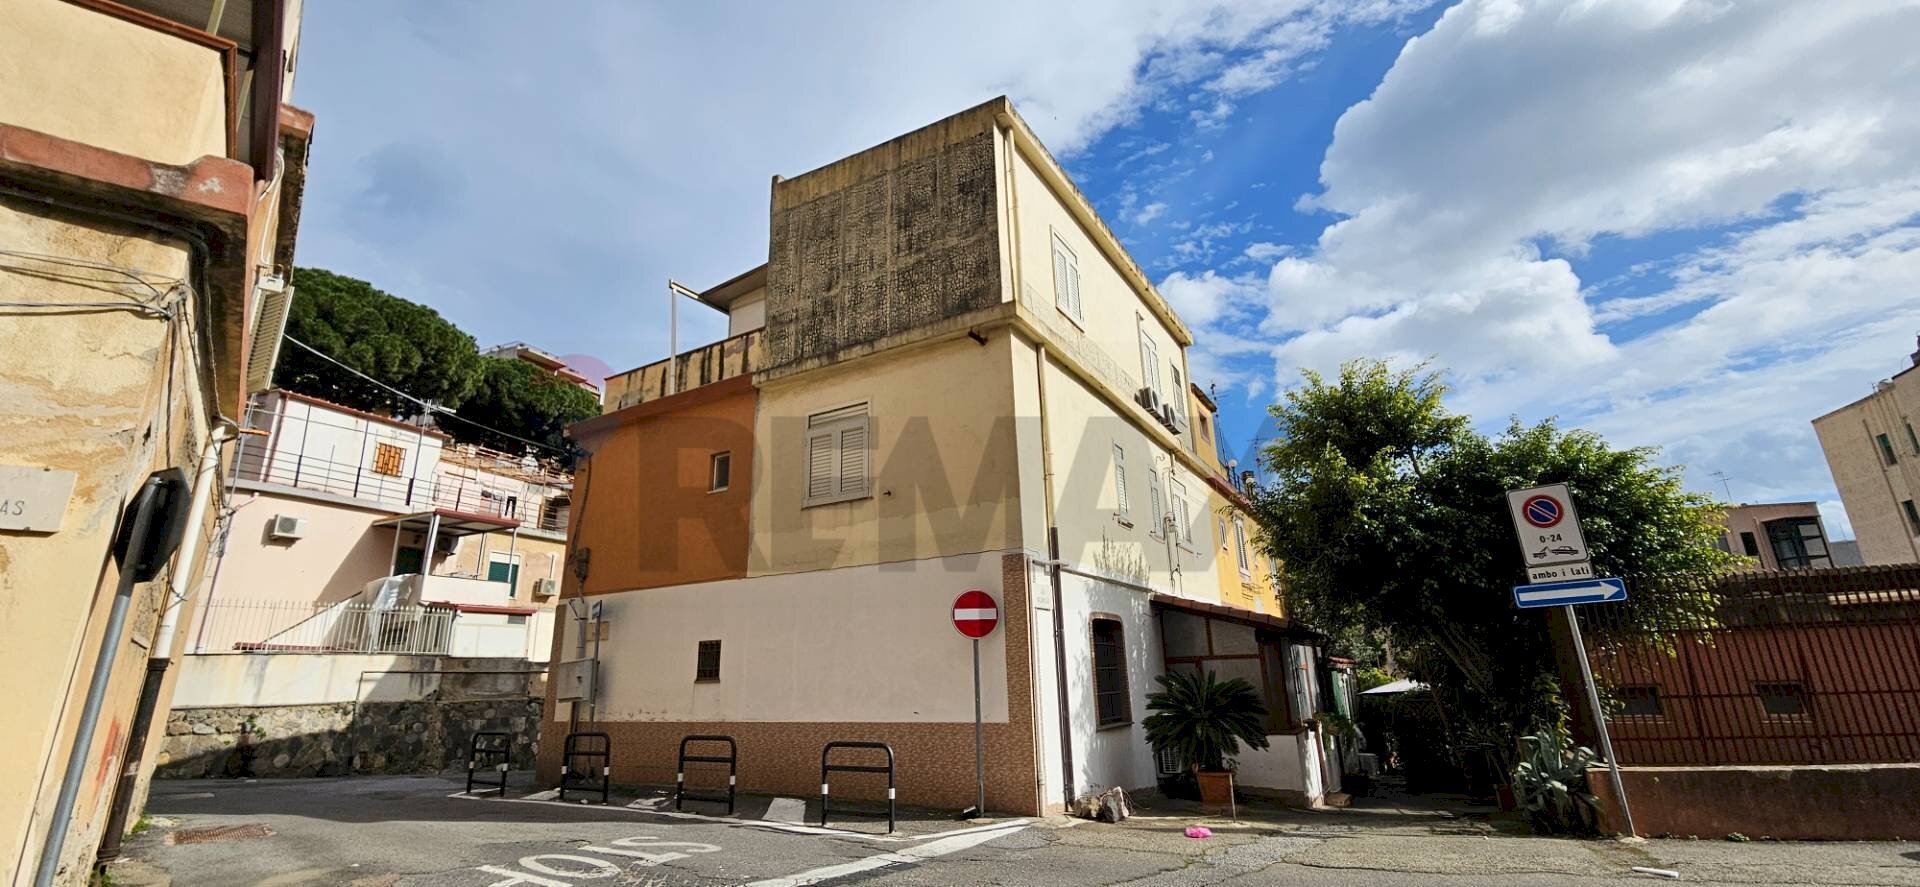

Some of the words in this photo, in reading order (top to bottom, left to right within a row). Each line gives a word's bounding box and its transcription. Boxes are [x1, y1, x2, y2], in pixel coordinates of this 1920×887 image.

[1539, 533, 1562, 543] 0-24
[1532, 570, 1557, 580] ambo
[1562, 568, 1566, 577] i
[1570, 566, 1590, 576] lati
